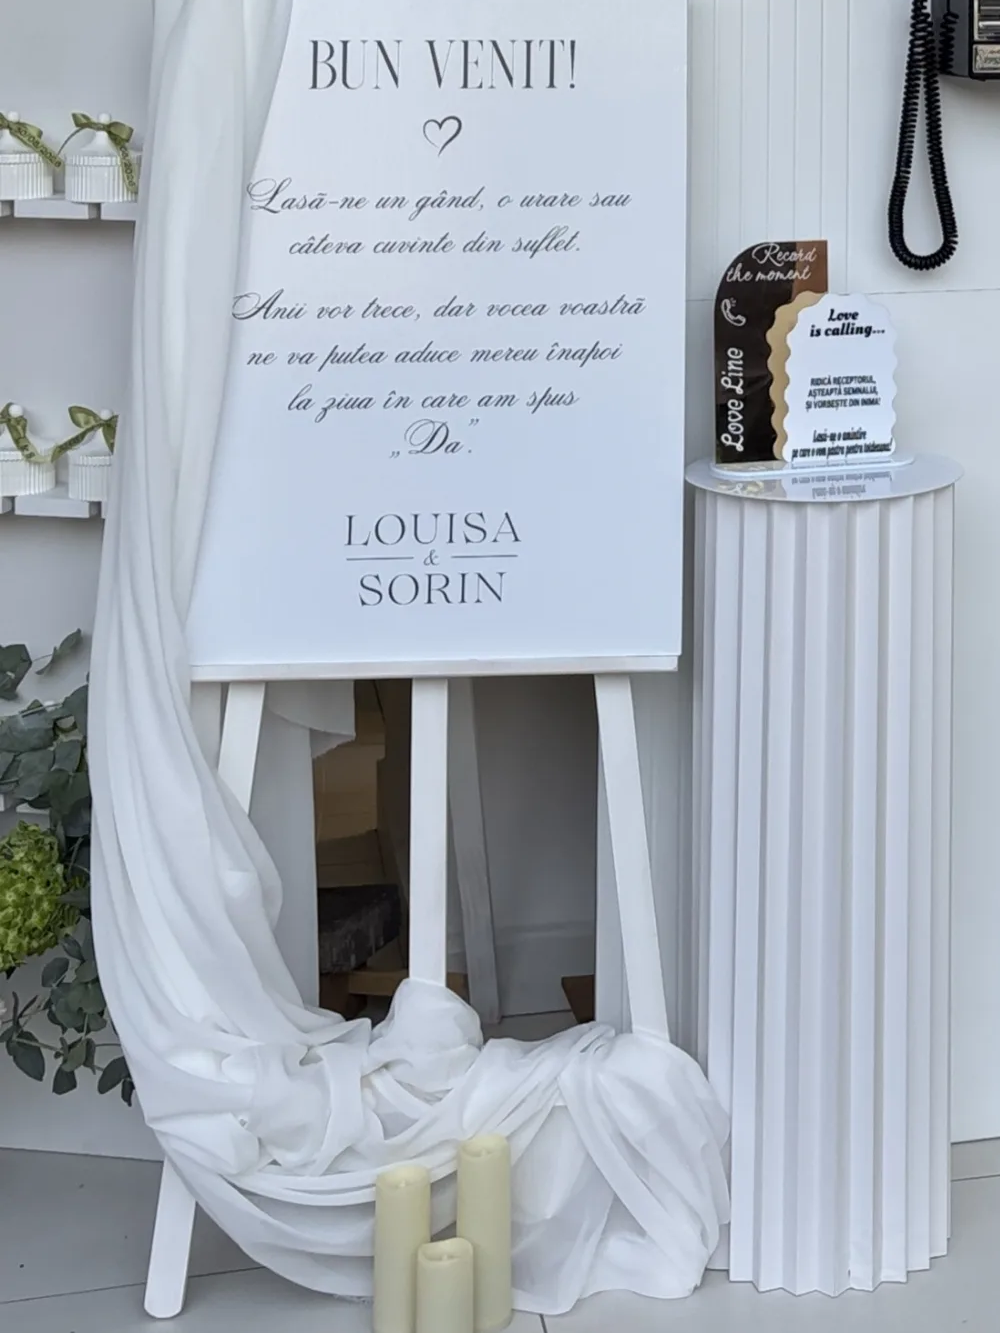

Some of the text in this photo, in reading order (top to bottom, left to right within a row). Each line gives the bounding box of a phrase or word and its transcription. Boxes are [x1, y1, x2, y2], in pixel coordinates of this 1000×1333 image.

[308, 39, 578, 90] BUN VENIT!
[375, 195, 409, 209] un
[408, 186, 485, 221] gând,
[497, 194, 514, 208] o
[519, 192, 583, 208] urare
[589, 191, 632, 207] sau
[288, 225, 581, 259] câteva cuvinte din suflet.
[752, 243, 818, 266] Record
[726, 263, 812, 282] the moment
[231, 288, 308, 320] Anii
[316, 304, 356, 319] vor
[361, 297, 421, 321] trece,
[433, 295, 478, 317] dar
[486, 302, 550, 317] vocea
[827, 309, 859, 322] Love
[810, 322, 885, 339] is calling...
[247, 340, 623, 372] ne va putea aduce mereu înapoi
[287, 384, 580, 423] la ziua în care am spus
[721, 347, 744, 452] Love Line
[344, 512, 522, 547] LOUISA
[423, 550, 440, 566] &
[358, 572, 507, 606] SORIN
